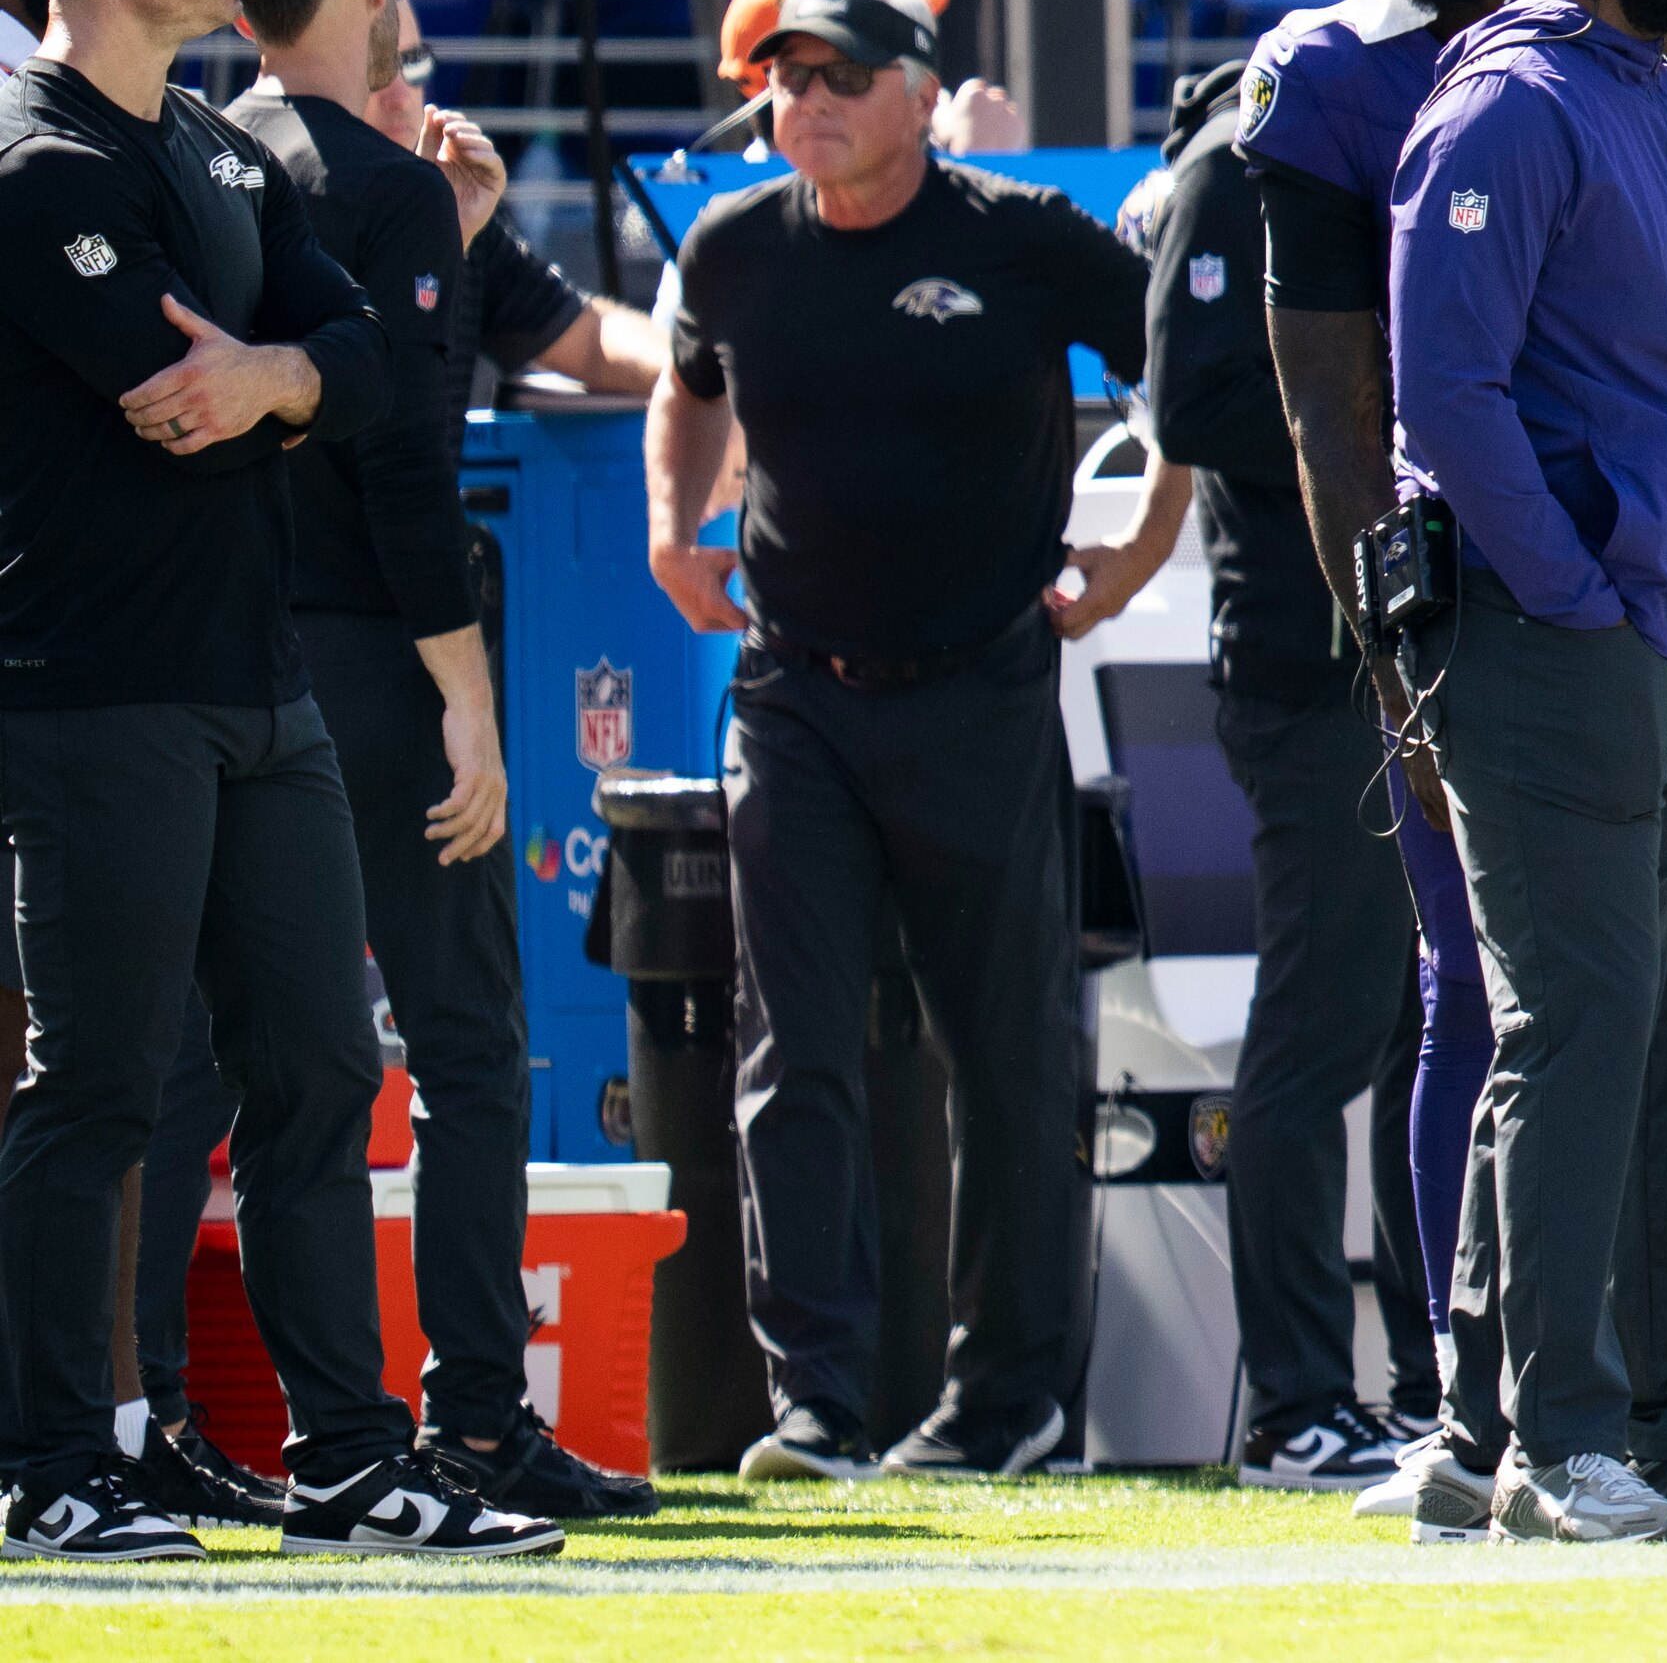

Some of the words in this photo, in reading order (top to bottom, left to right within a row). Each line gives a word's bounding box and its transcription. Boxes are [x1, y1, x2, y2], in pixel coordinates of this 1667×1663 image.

[1454, 207, 1481, 226] NFL
[79, 247, 113, 274] NFL
[1354, 541, 1367, 611] SONY
[582, 709, 628, 760] NFL
